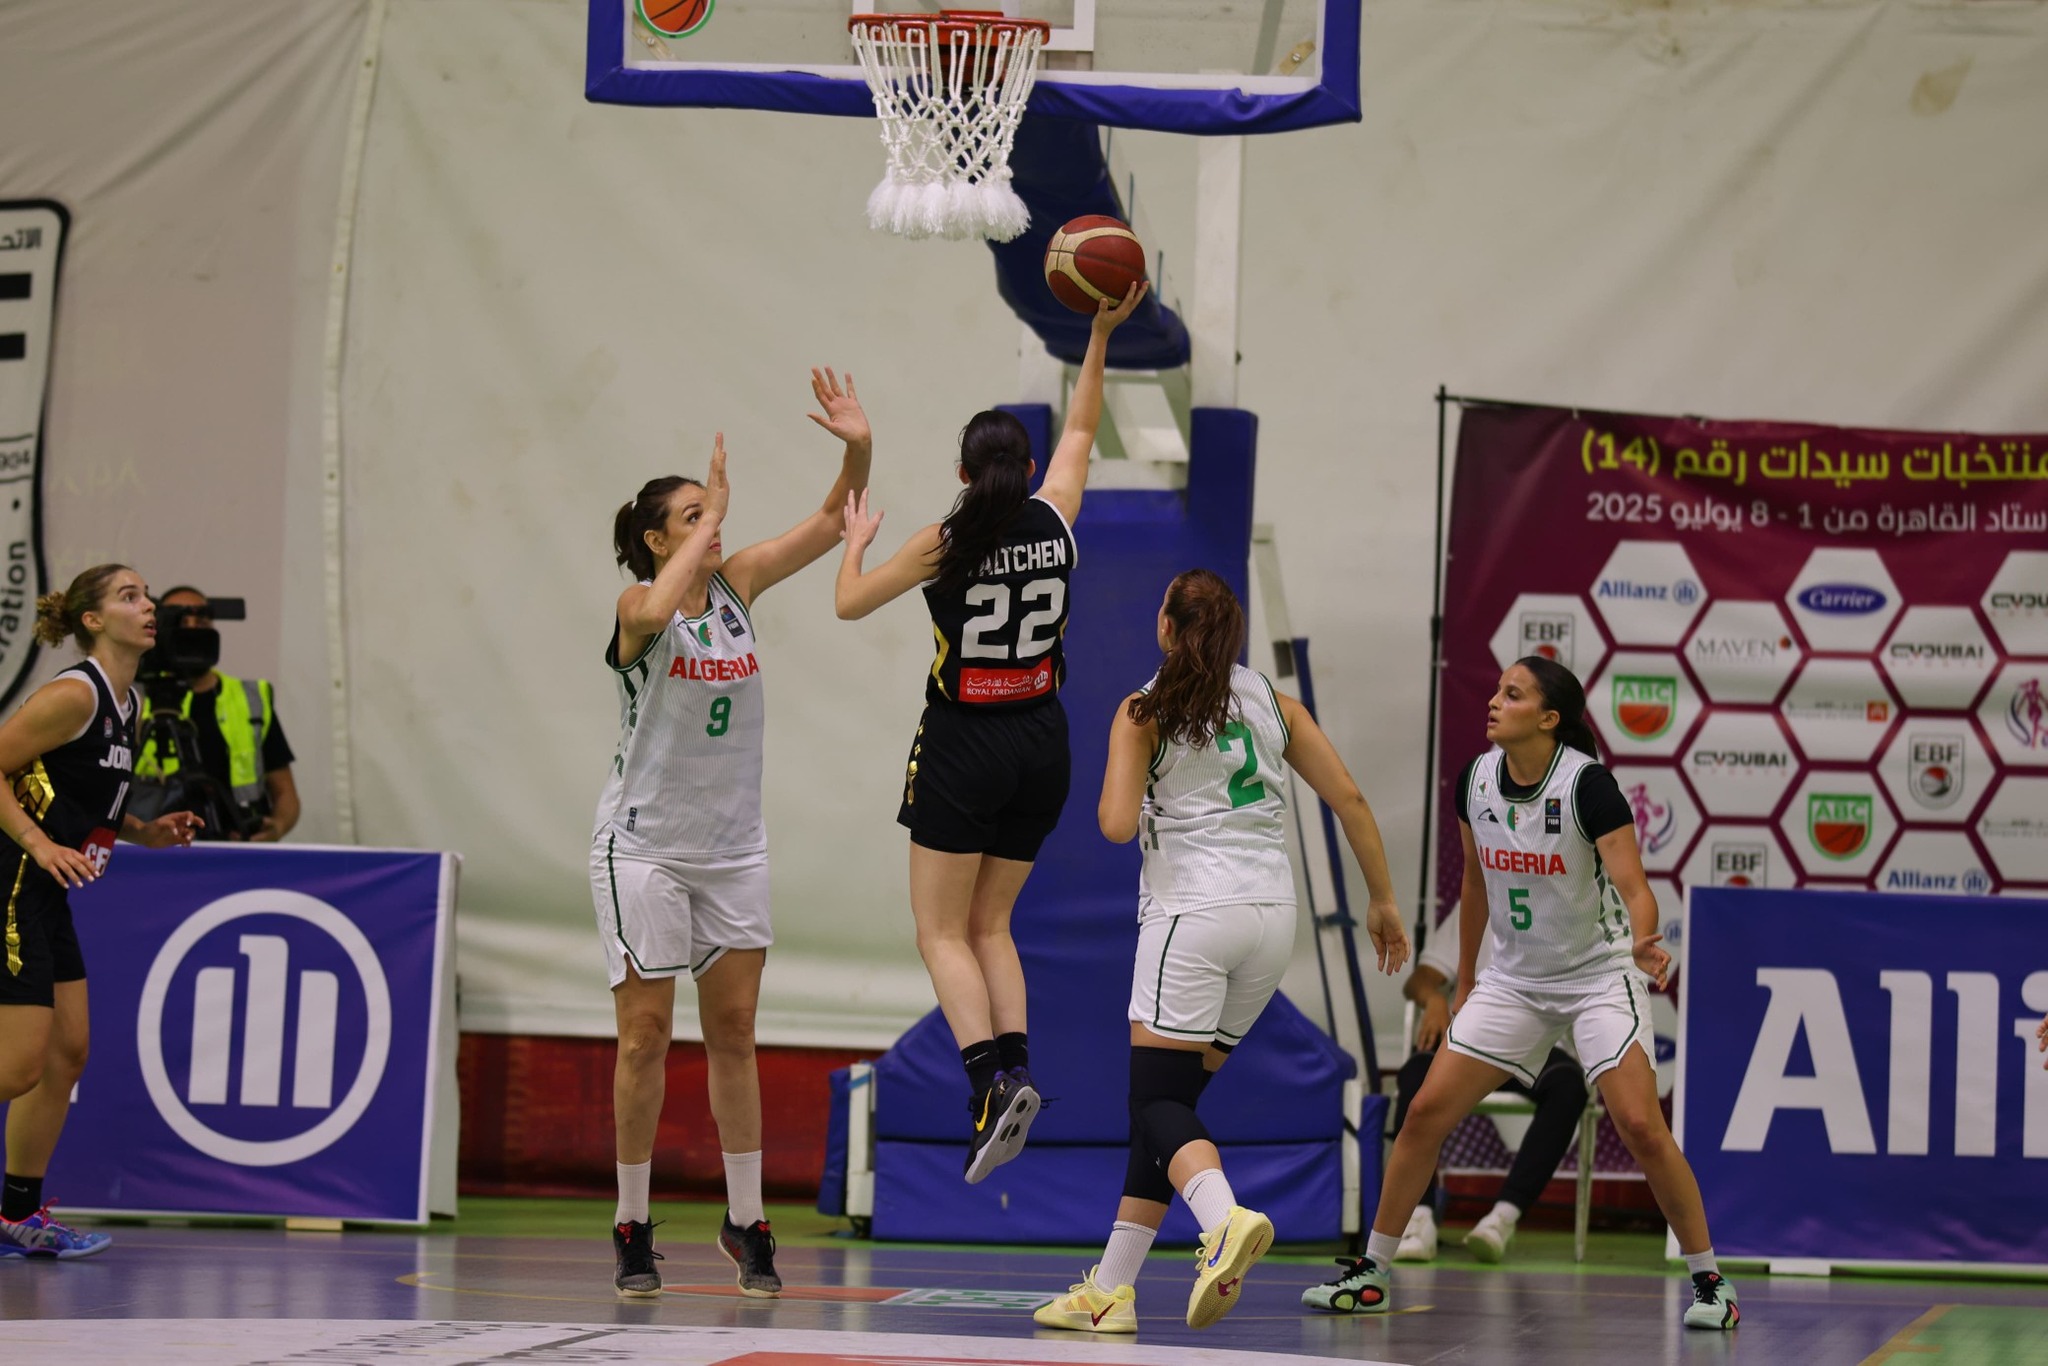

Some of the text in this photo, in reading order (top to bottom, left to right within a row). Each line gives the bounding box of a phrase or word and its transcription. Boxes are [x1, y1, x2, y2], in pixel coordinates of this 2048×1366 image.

[1581, 428, 1661, 478] (14)
[1674, 439, 1748, 486] رقم
[1760, 440, 1890, 489] سيدات
[1586, 492, 1663, 523] 2025
[1669, 496, 1743, 533] يوليو
[1750, 501, 1770, 527] 8
[1799, 503, 1813, 529] 1
[1824, 506, 1869, 534] من
[1877, 503, 1977, 536] القاهرة
[0, 541, 27, 664] ration
[1597, 579, 1668, 600] Allianz
[1808, 588, 1877, 608] Carrier
[961, 577, 1066, 660] 22
[1524, 620, 1570, 641] EBF
[1696, 638, 1777, 658] MAVEN
[668, 652, 760, 682] ALGERIA
[966, 686, 1031, 697] ROYAL JORDANIAN
[1619, 682, 1672, 700] ABC
[706, 696, 732, 738] 9
[1215, 720, 1266, 809] 2
[1914, 743, 1960, 763] EBF
[1814, 802, 1866, 821] ABC
[1717, 852, 1762, 872] EBF
[1887, 869, 1957, 890] Allianz
[1508, 888, 1533, 931] 5
[1720, 966, 2048, 1160] Alli
